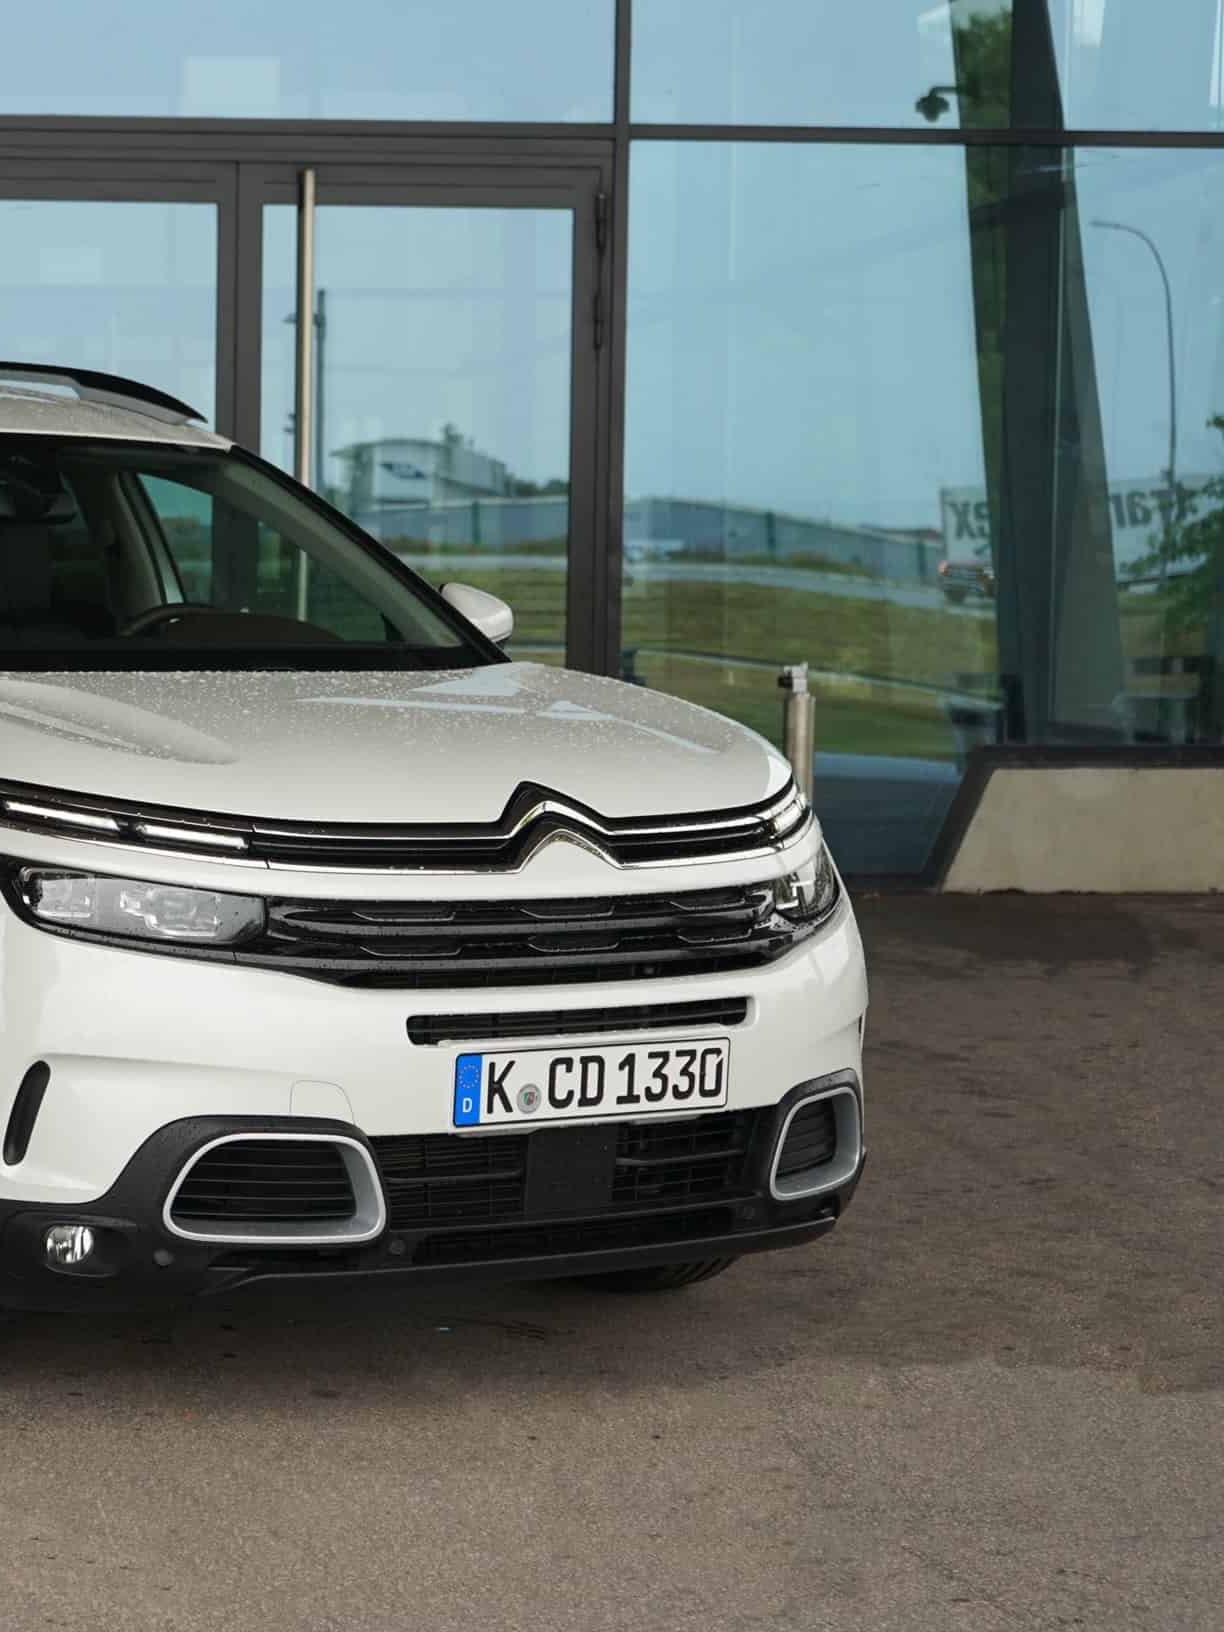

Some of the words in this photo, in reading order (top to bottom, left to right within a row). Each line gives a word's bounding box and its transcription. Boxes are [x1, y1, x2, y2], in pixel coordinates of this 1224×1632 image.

[462, 1097, 473, 1113] D
[486, 1060, 516, 1115] K
[548, 1055, 606, 1109] CD
[616, 1047, 724, 1105] 1330
